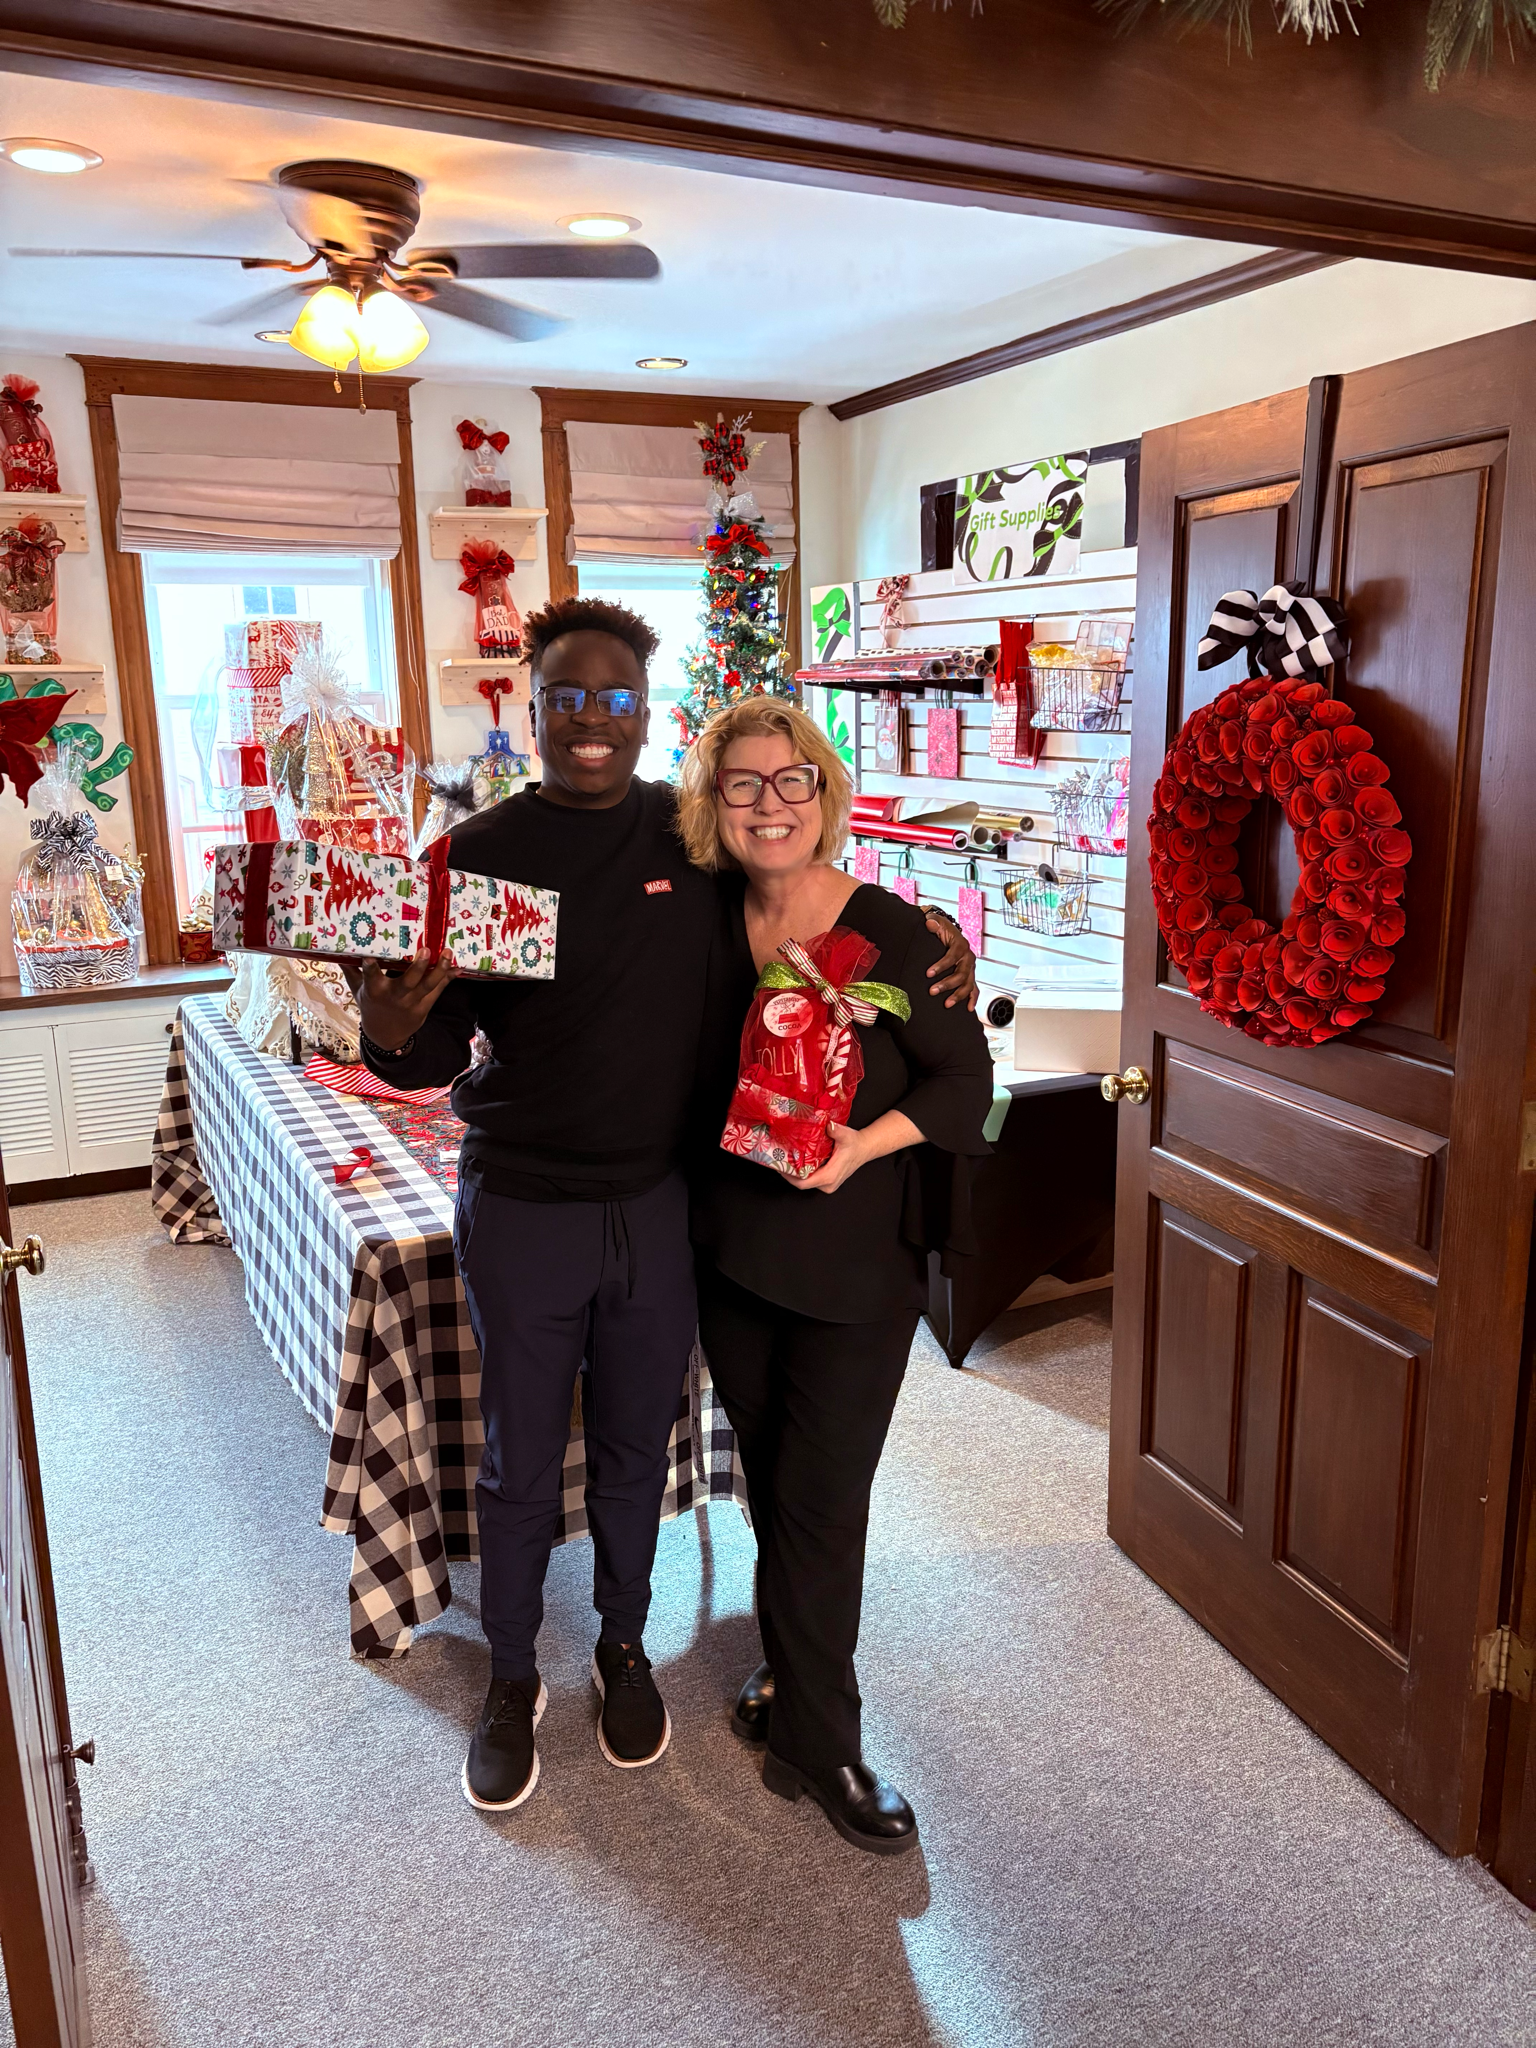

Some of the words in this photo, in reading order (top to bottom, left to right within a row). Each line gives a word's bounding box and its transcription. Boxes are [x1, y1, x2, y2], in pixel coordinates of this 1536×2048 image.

[970, 511, 996, 531] Gift
[999, 502, 1061, 531] Supplies
[487, 616, 509, 628] DAD
[645, 880, 671, 893] MARVEL
[778, 1022, 802, 1031] COCOA
[756, 1044, 799, 1076] JOLLY
